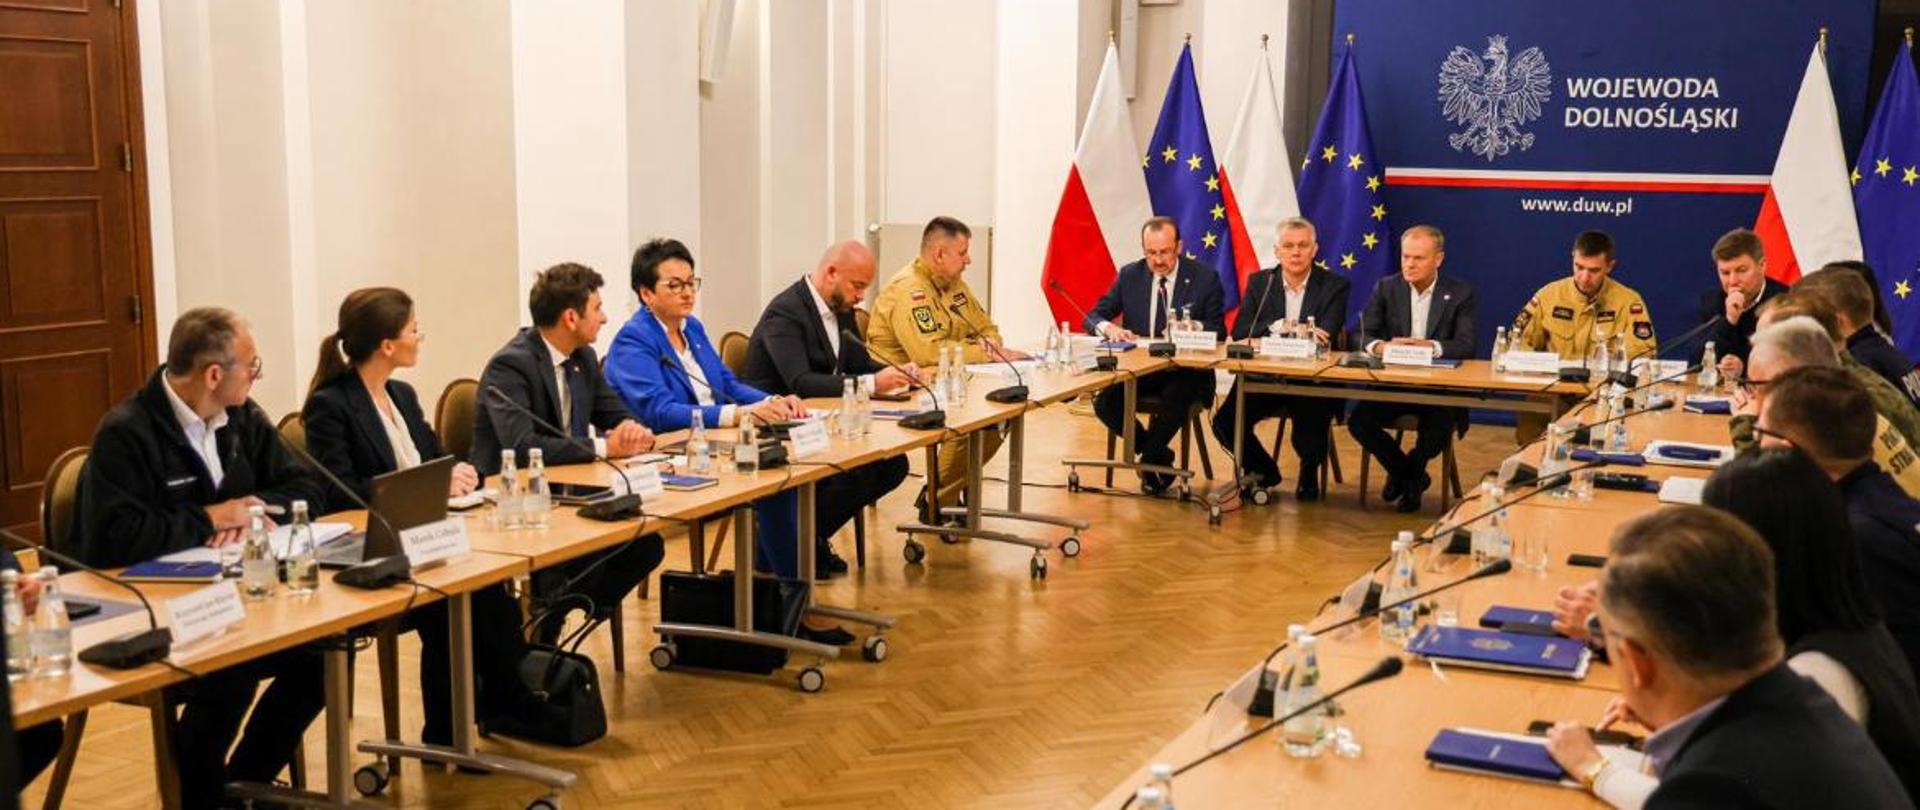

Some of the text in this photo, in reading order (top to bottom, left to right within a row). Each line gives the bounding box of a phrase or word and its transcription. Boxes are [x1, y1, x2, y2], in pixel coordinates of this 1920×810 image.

[1566, 77, 1720, 100] WOJEWODA
[1564, 102, 1739, 133] DOLNOŚLĄSKI
[1521, 196, 1633, 216] www.duw.pl
